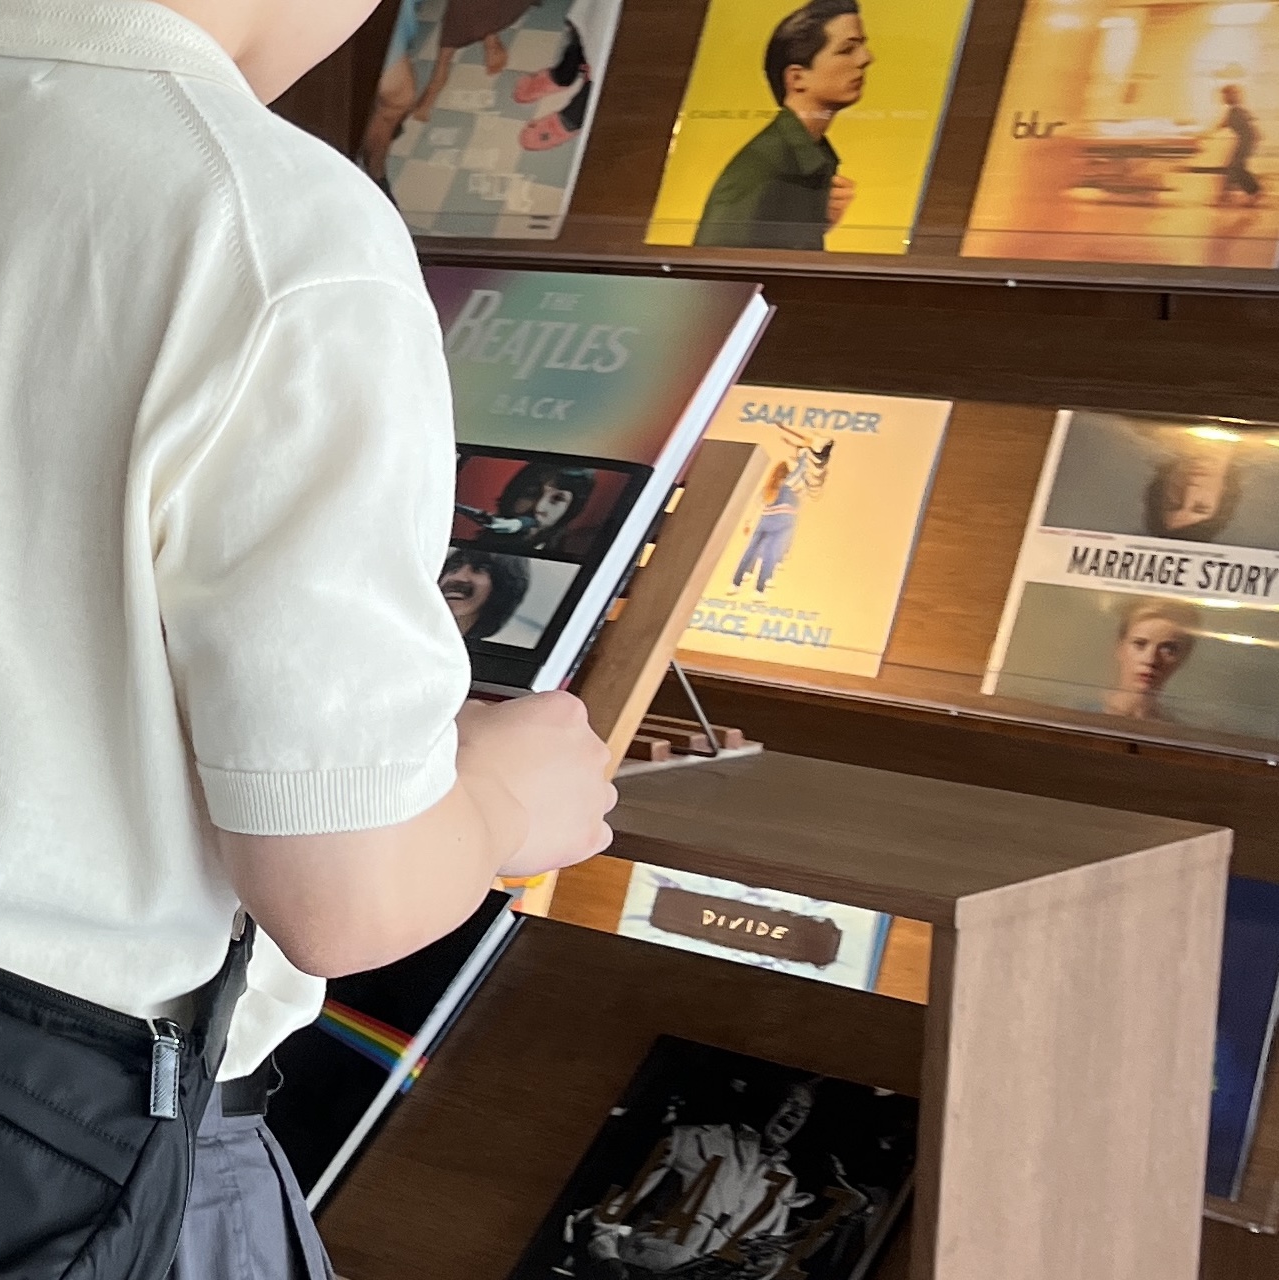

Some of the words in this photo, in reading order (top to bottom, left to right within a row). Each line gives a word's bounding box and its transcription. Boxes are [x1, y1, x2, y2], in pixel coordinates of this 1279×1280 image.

[1011, 110, 1067, 139] blur
[444, 289, 639, 380] BEATLES
[740, 402, 795, 426] SAM
[802, 407, 881, 434] RYDER
[1066, 545, 1191, 587] MARRIAGE
[1198, 559, 1278, 597] STORY
[688, 609, 748, 641] PACE,
[702, 909, 789, 940] DIVIDE
